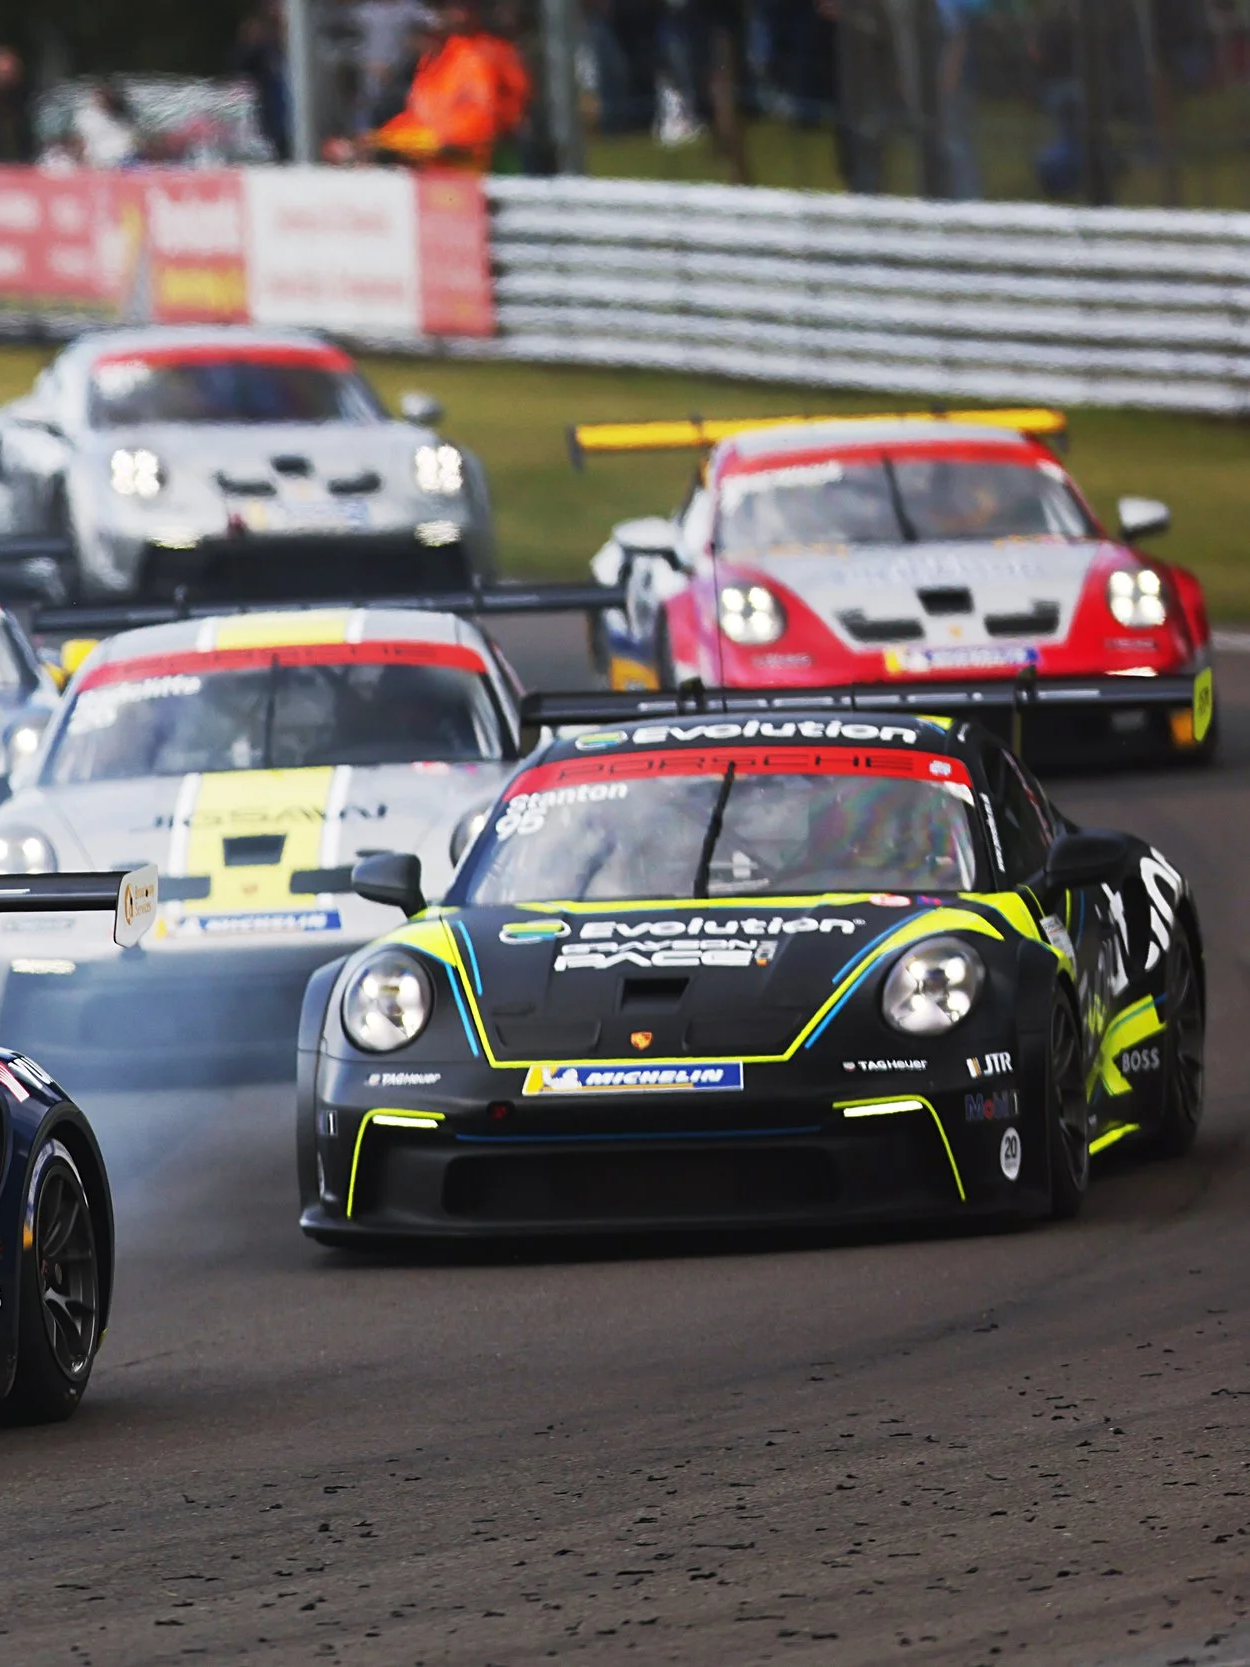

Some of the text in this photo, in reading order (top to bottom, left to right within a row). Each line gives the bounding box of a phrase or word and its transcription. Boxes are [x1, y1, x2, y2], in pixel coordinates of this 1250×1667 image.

[632, 720, 916, 745] Evolution
[559, 753, 914, 780] PORSCHE
[507, 783, 628, 812] Stanton
[495, 811, 544, 841] 95
[580, 917, 855, 939] Evolution
[983, 1052, 1013, 1076] JTR
[1122, 1047, 1160, 1073] BOSS
[585, 1068, 725, 1086] MICHELIN
[1004, 1136, 1017, 1159] 20
